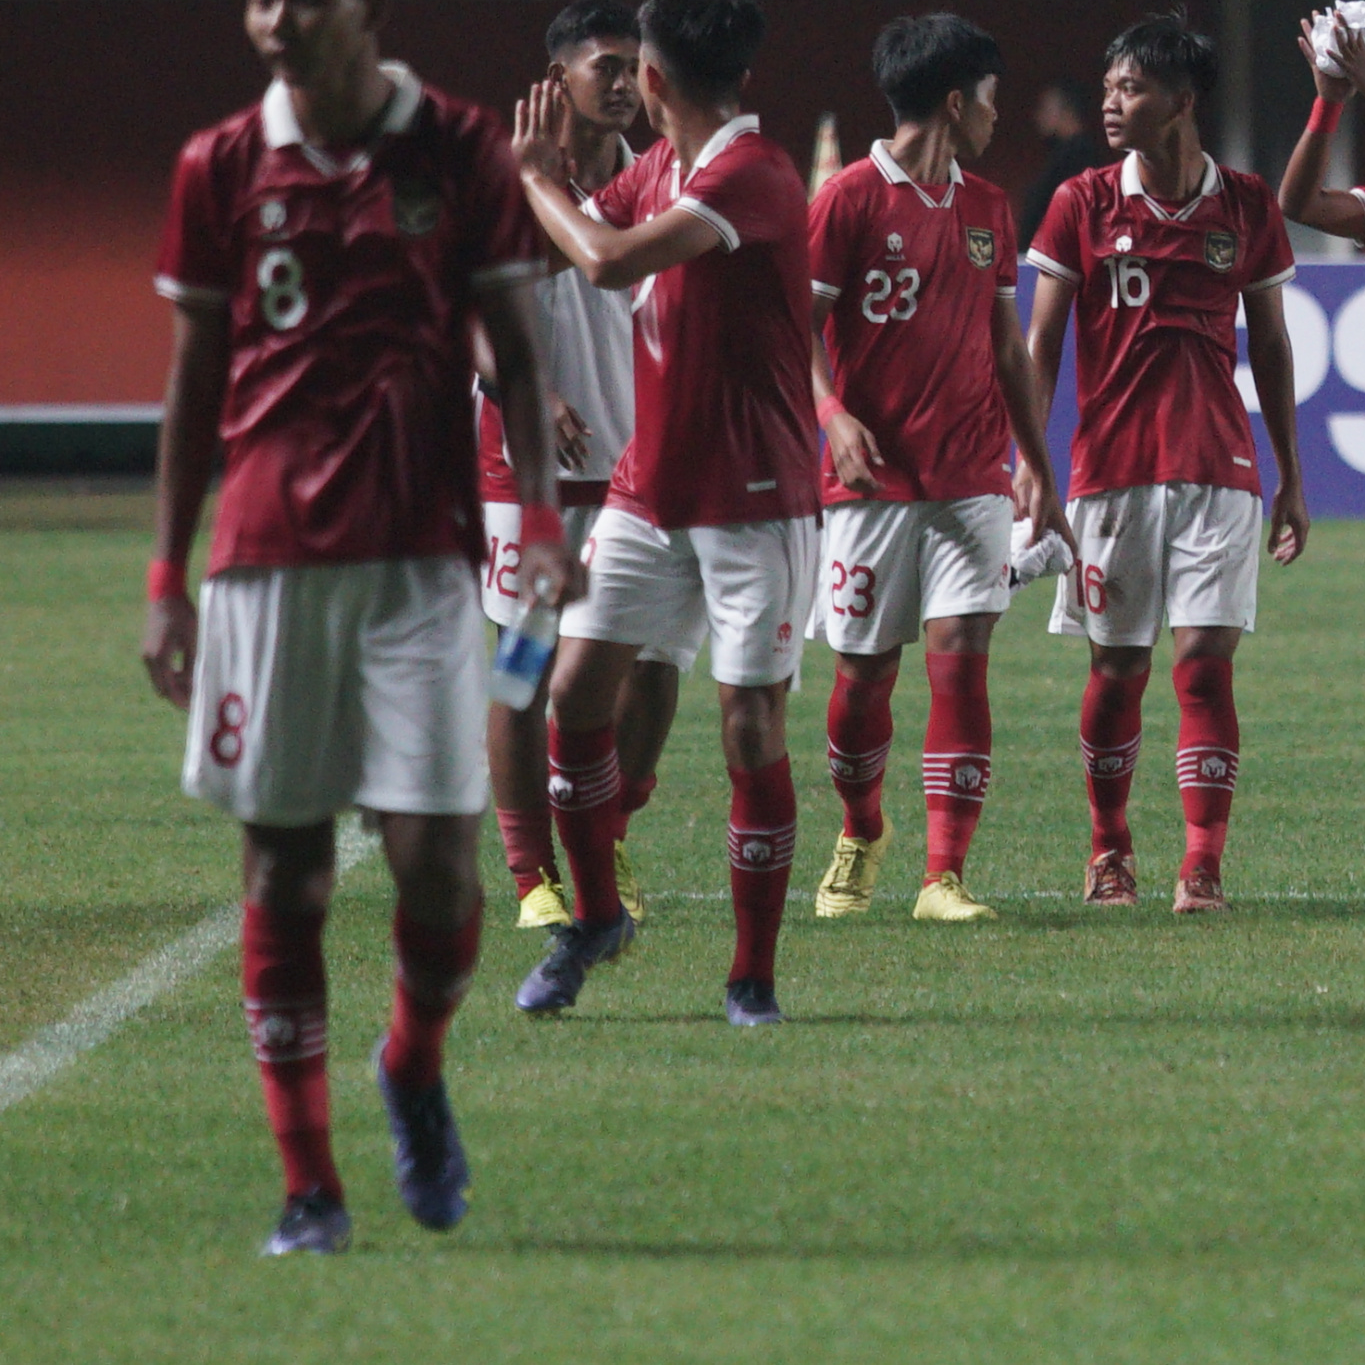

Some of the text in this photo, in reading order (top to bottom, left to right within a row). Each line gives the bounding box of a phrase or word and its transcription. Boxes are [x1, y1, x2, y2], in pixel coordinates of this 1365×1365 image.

[256, 248, 308, 330] 8
[862, 268, 919, 323] 23
[1103, 256, 1151, 309] 16
[486, 536, 521, 599] 12
[832, 560, 876, 618] 23
[1075, 558, 1106, 615] 16
[210, 692, 246, 769] 8
